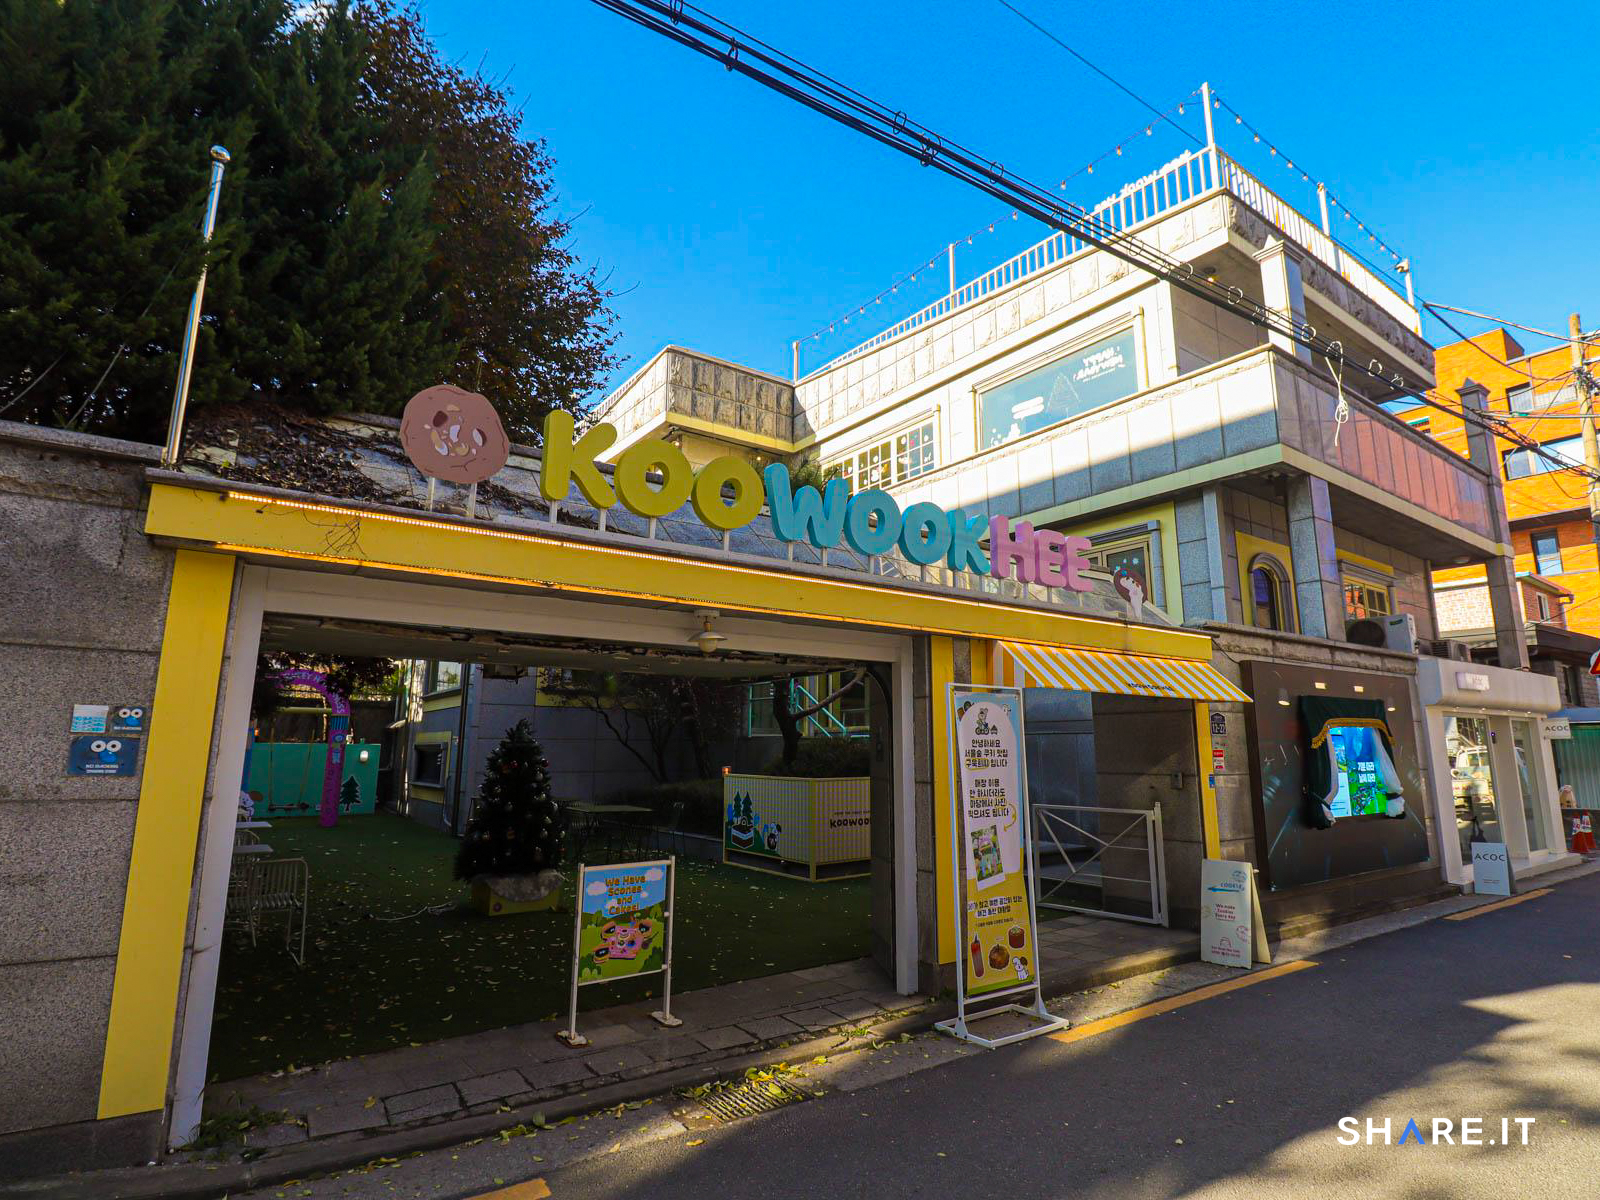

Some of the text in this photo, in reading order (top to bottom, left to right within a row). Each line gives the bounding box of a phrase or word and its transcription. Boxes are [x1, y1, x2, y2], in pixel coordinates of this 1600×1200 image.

[972, 739, 1000, 748] 안녕하세요
[964, 749, 982, 758] 서울숲
[830, 818, 872, 829] KOOWOO
[1474, 853, 1506, 862] ACOC
[605, 876, 646, 887] We Have
